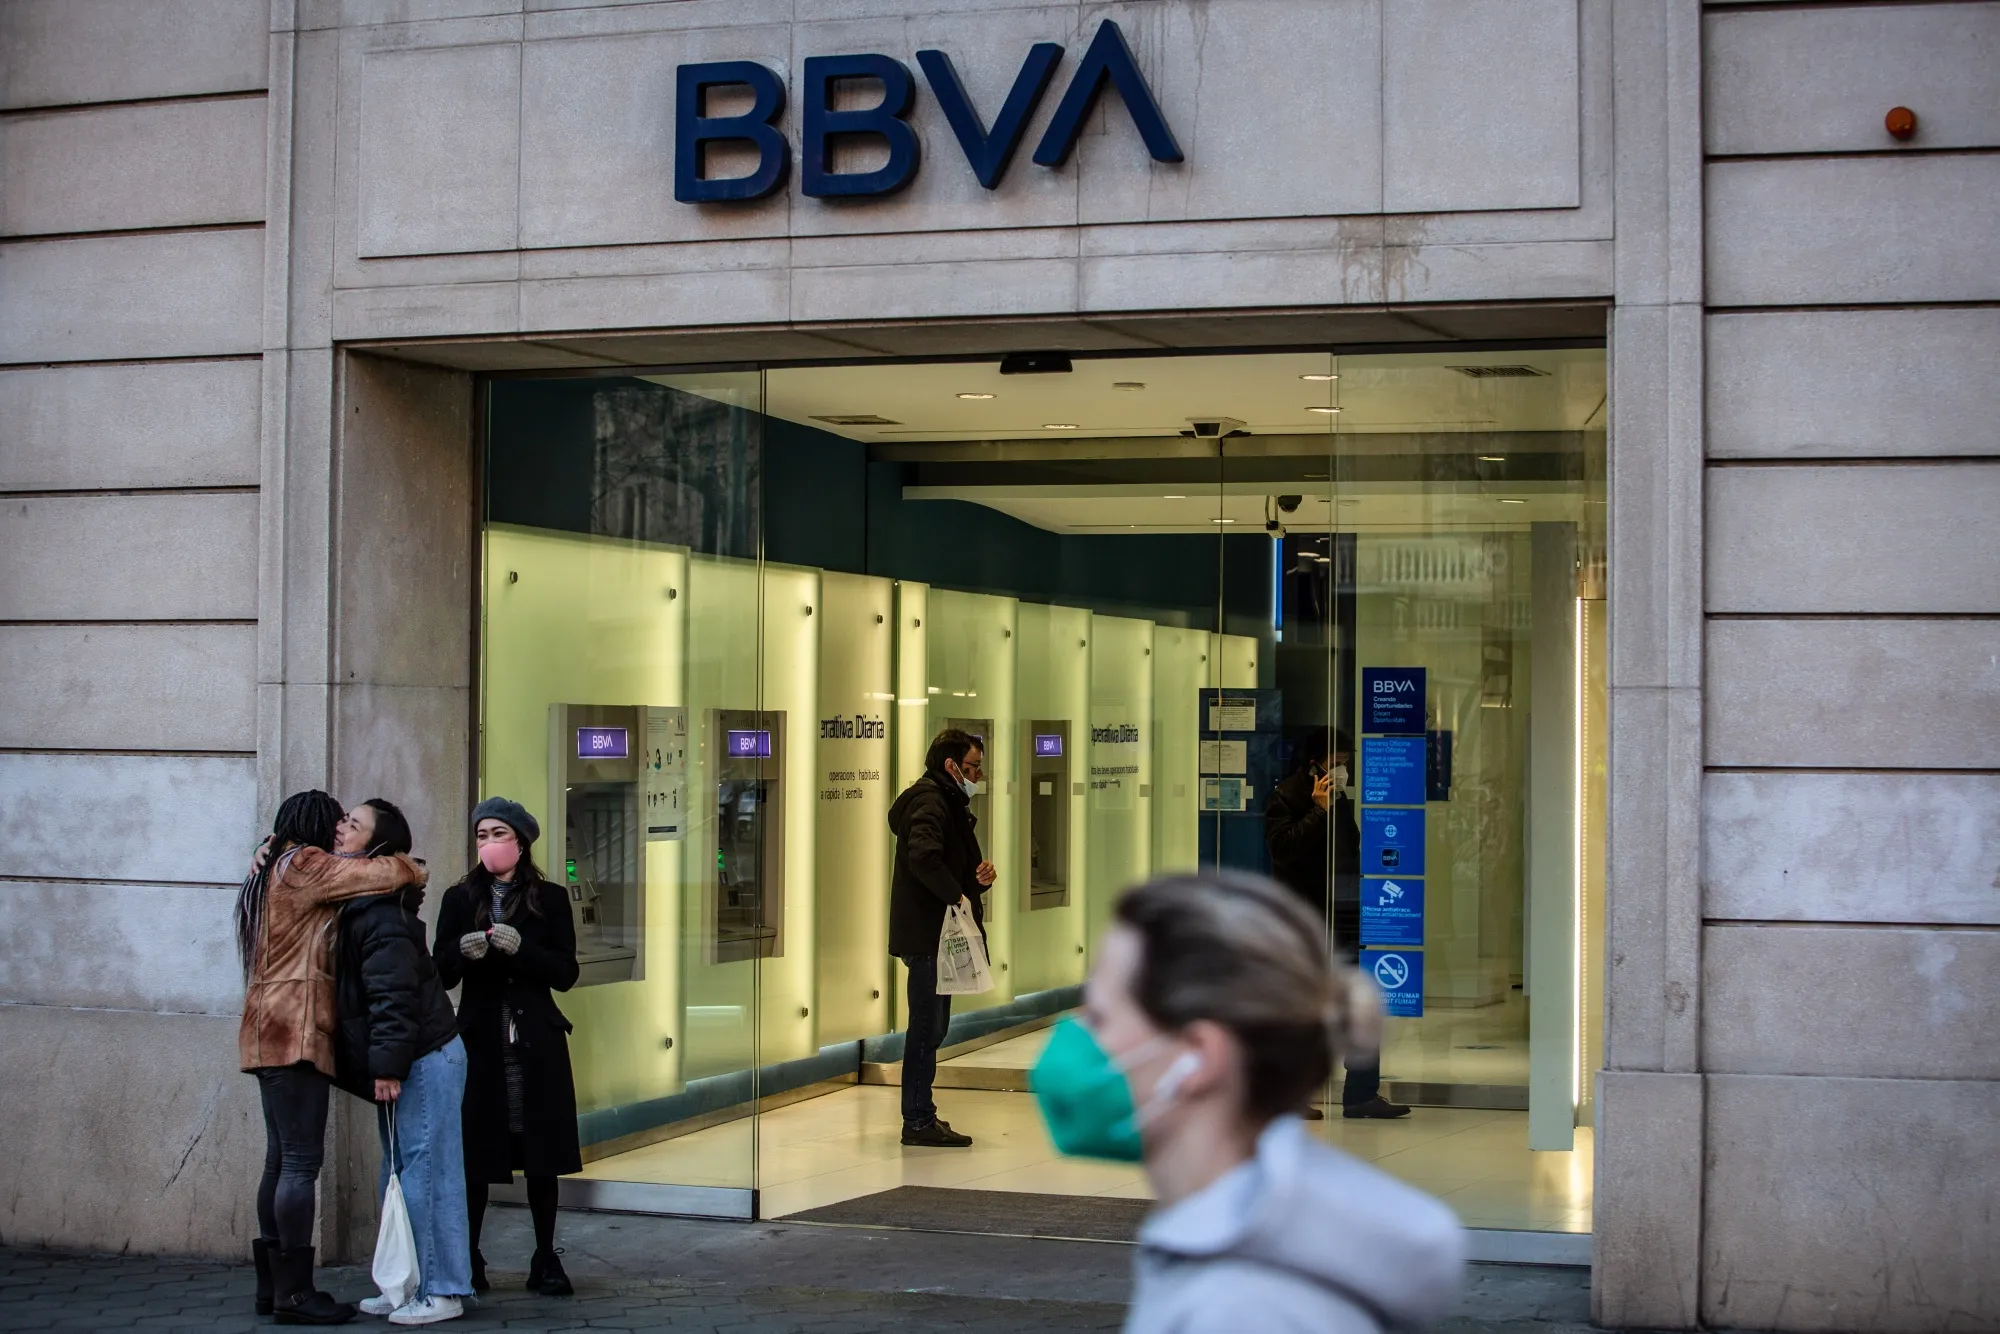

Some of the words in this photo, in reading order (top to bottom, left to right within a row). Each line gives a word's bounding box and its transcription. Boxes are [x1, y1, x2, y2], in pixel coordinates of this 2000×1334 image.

[675, 19, 1184, 204] BBVA
[1373, 680, 1415, 693] BBVA
[592, 734, 613, 749] BBVA
[740, 737, 756, 750] BBVA
[828, 769, 855, 783] operacions
[858, 768, 880, 781] habituals
